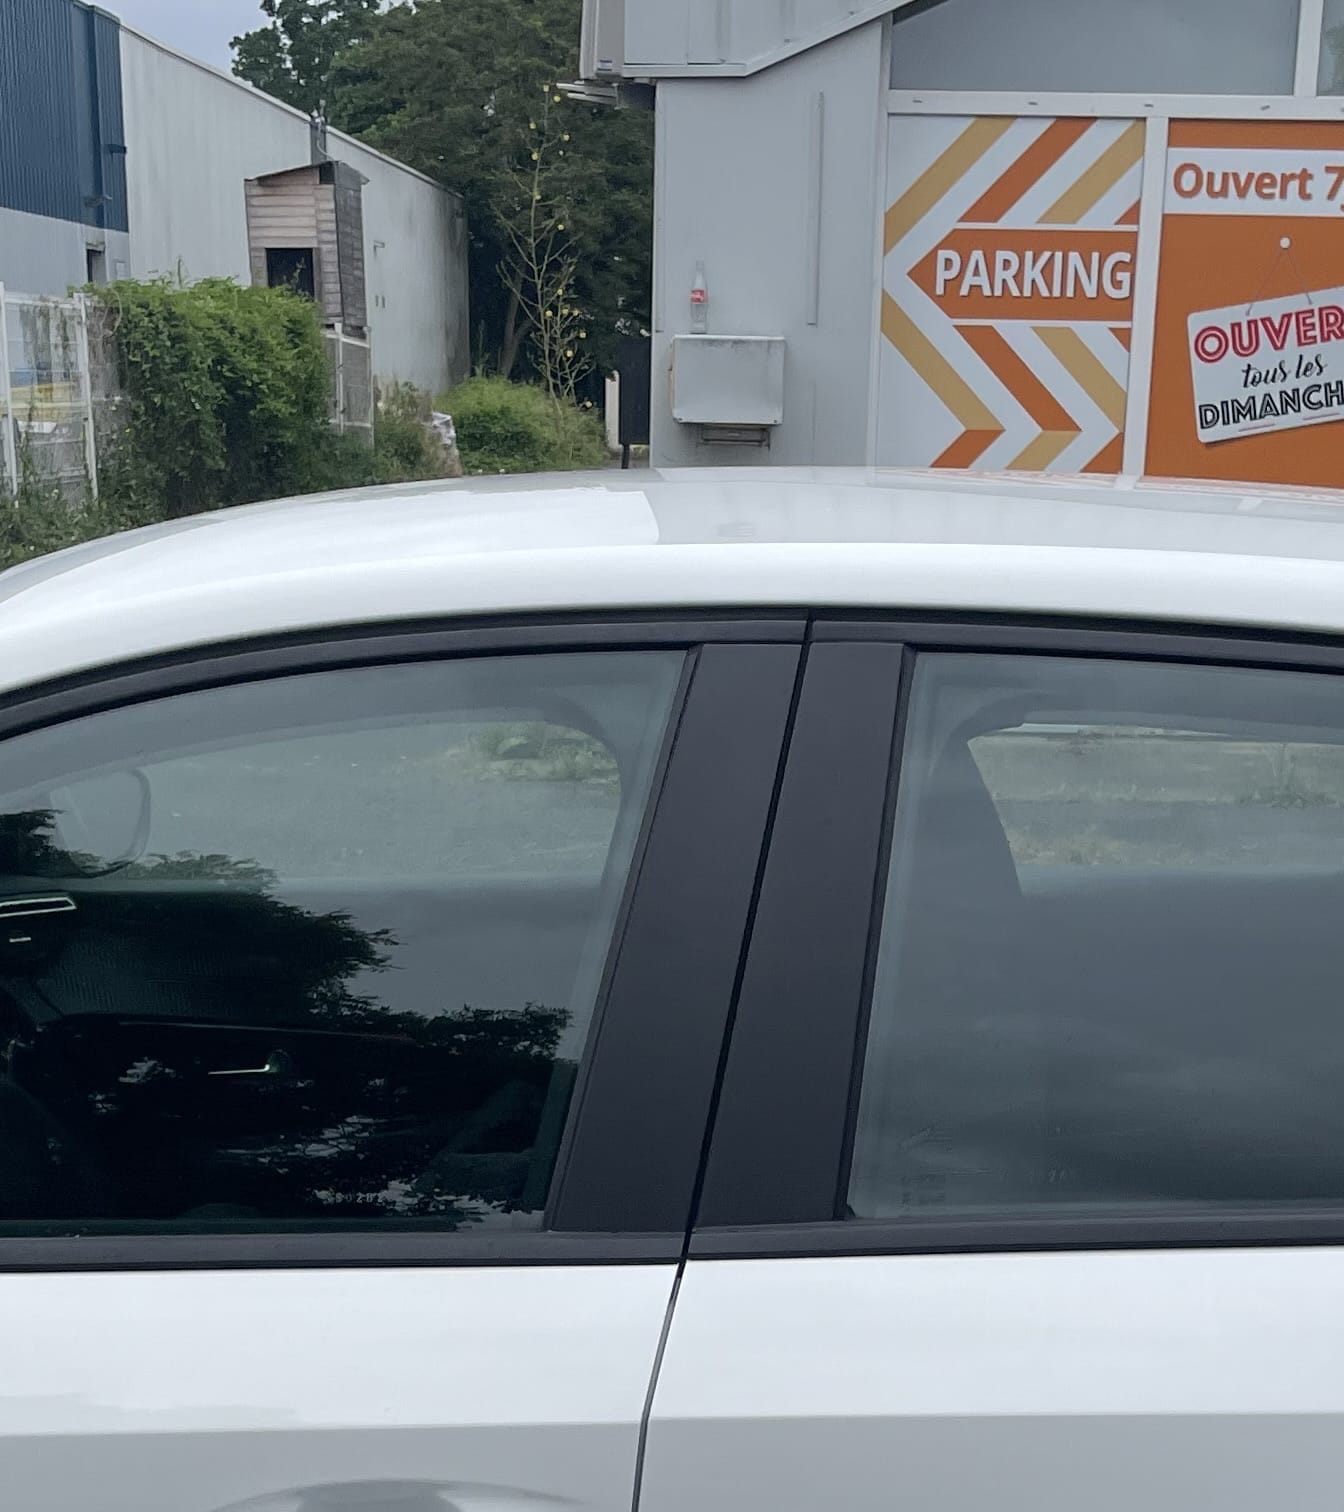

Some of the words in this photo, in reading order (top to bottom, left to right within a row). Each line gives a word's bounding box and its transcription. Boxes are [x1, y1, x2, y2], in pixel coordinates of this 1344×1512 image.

[1173, 162, 1314, 200] Ouvert
[935, 249, 1132, 300] PARKING
[1241, 359, 1291, 389] tous
[1295, 353, 1328, 379] les
